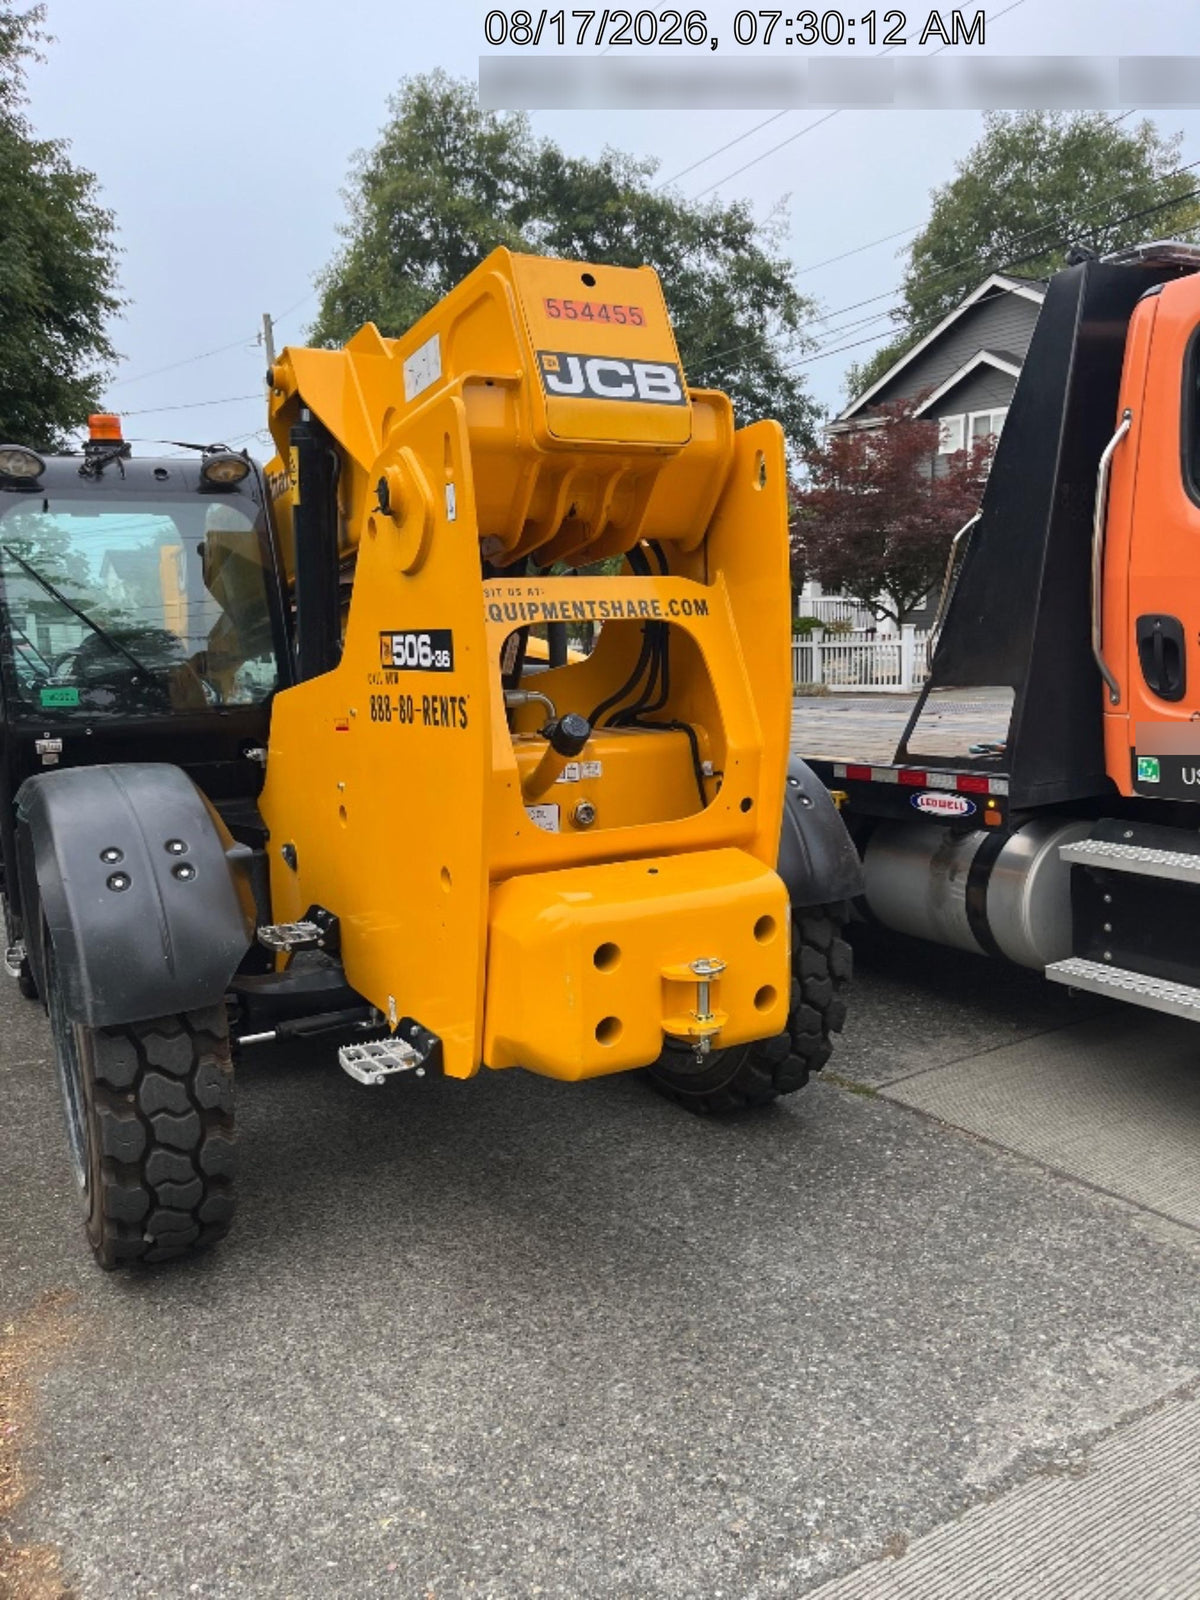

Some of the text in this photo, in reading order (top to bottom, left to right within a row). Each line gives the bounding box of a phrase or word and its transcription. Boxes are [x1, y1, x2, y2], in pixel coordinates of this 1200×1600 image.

[546, 298, 643, 326] 554455
[546, 356, 682, 401] JCB
[483, 599, 709, 622] QUIPMENTSHARE.COM
[392, 634, 451, 667] 506-36
[370, 694, 468, 729] 888-80-RENTS
[920, 797, 965, 811] LEDWELL
